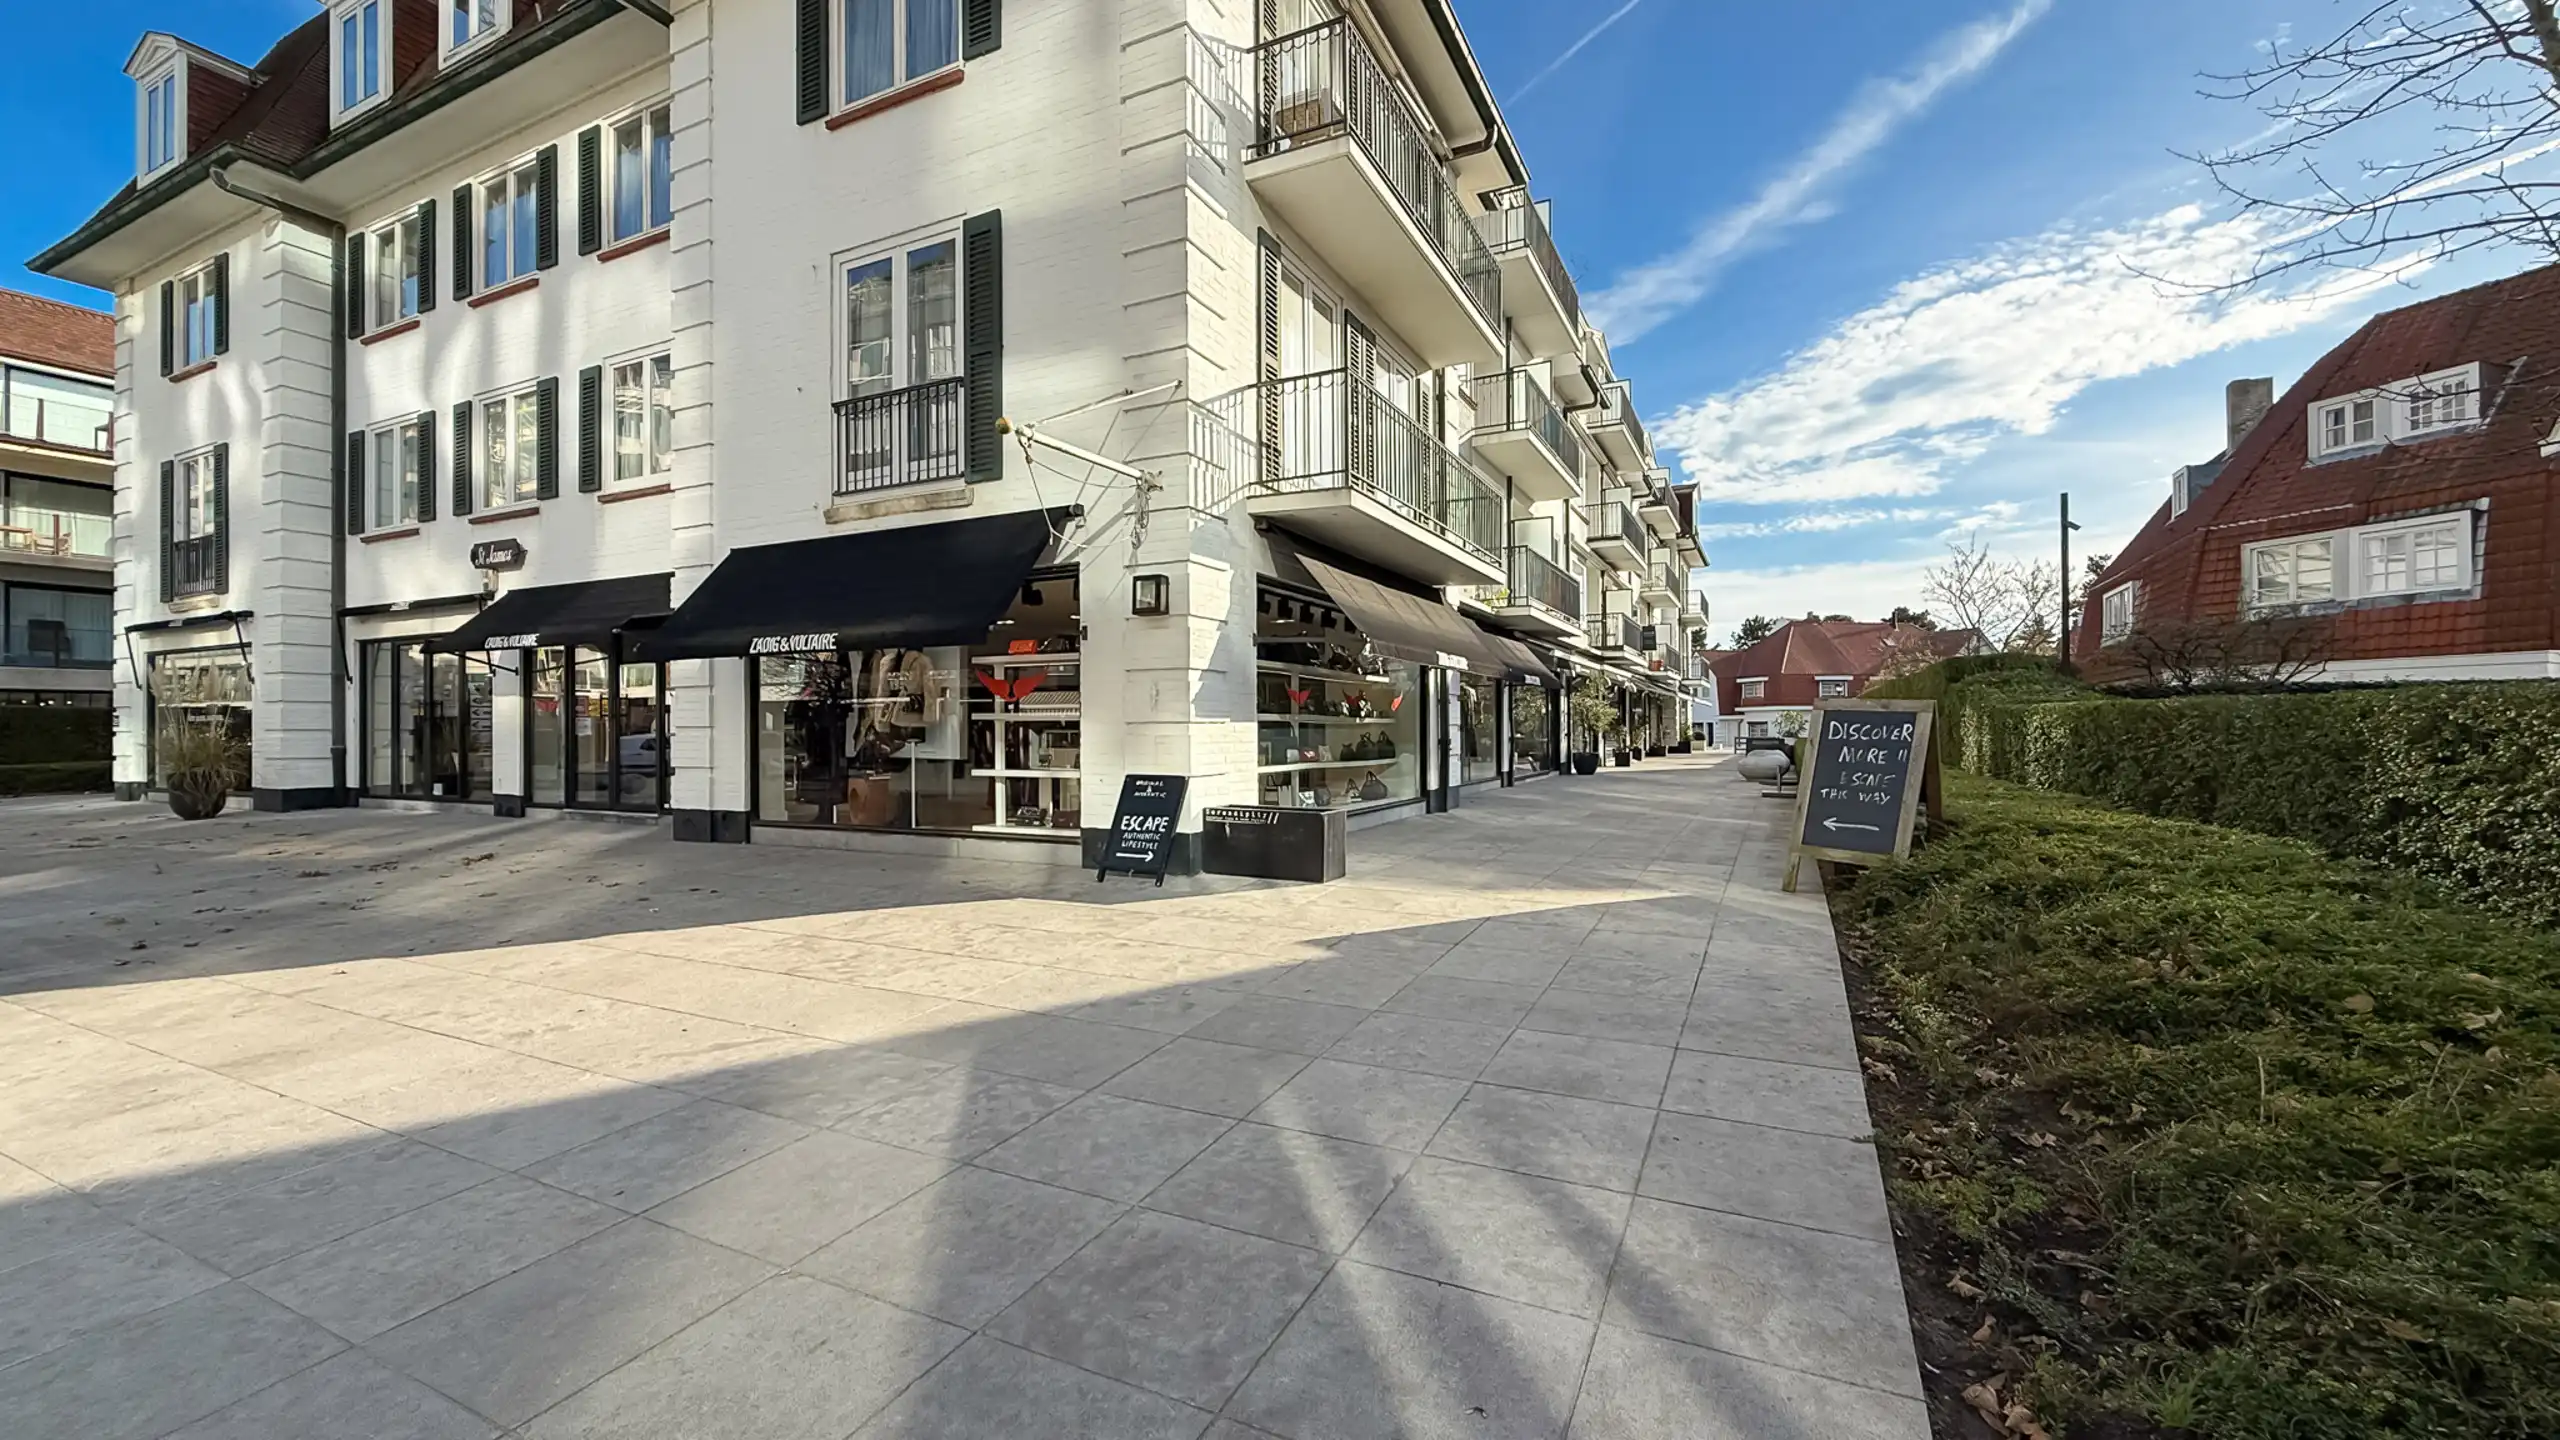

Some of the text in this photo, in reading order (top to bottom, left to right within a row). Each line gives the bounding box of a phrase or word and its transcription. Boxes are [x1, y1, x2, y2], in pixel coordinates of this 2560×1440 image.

[1828, 721, 1913, 742] DISCOVER
[1838, 746, 1888, 764] MORE
[1121, 816, 1169, 832] ESCAPE
[1123, 832, 1161, 840] AUTHENTIC
